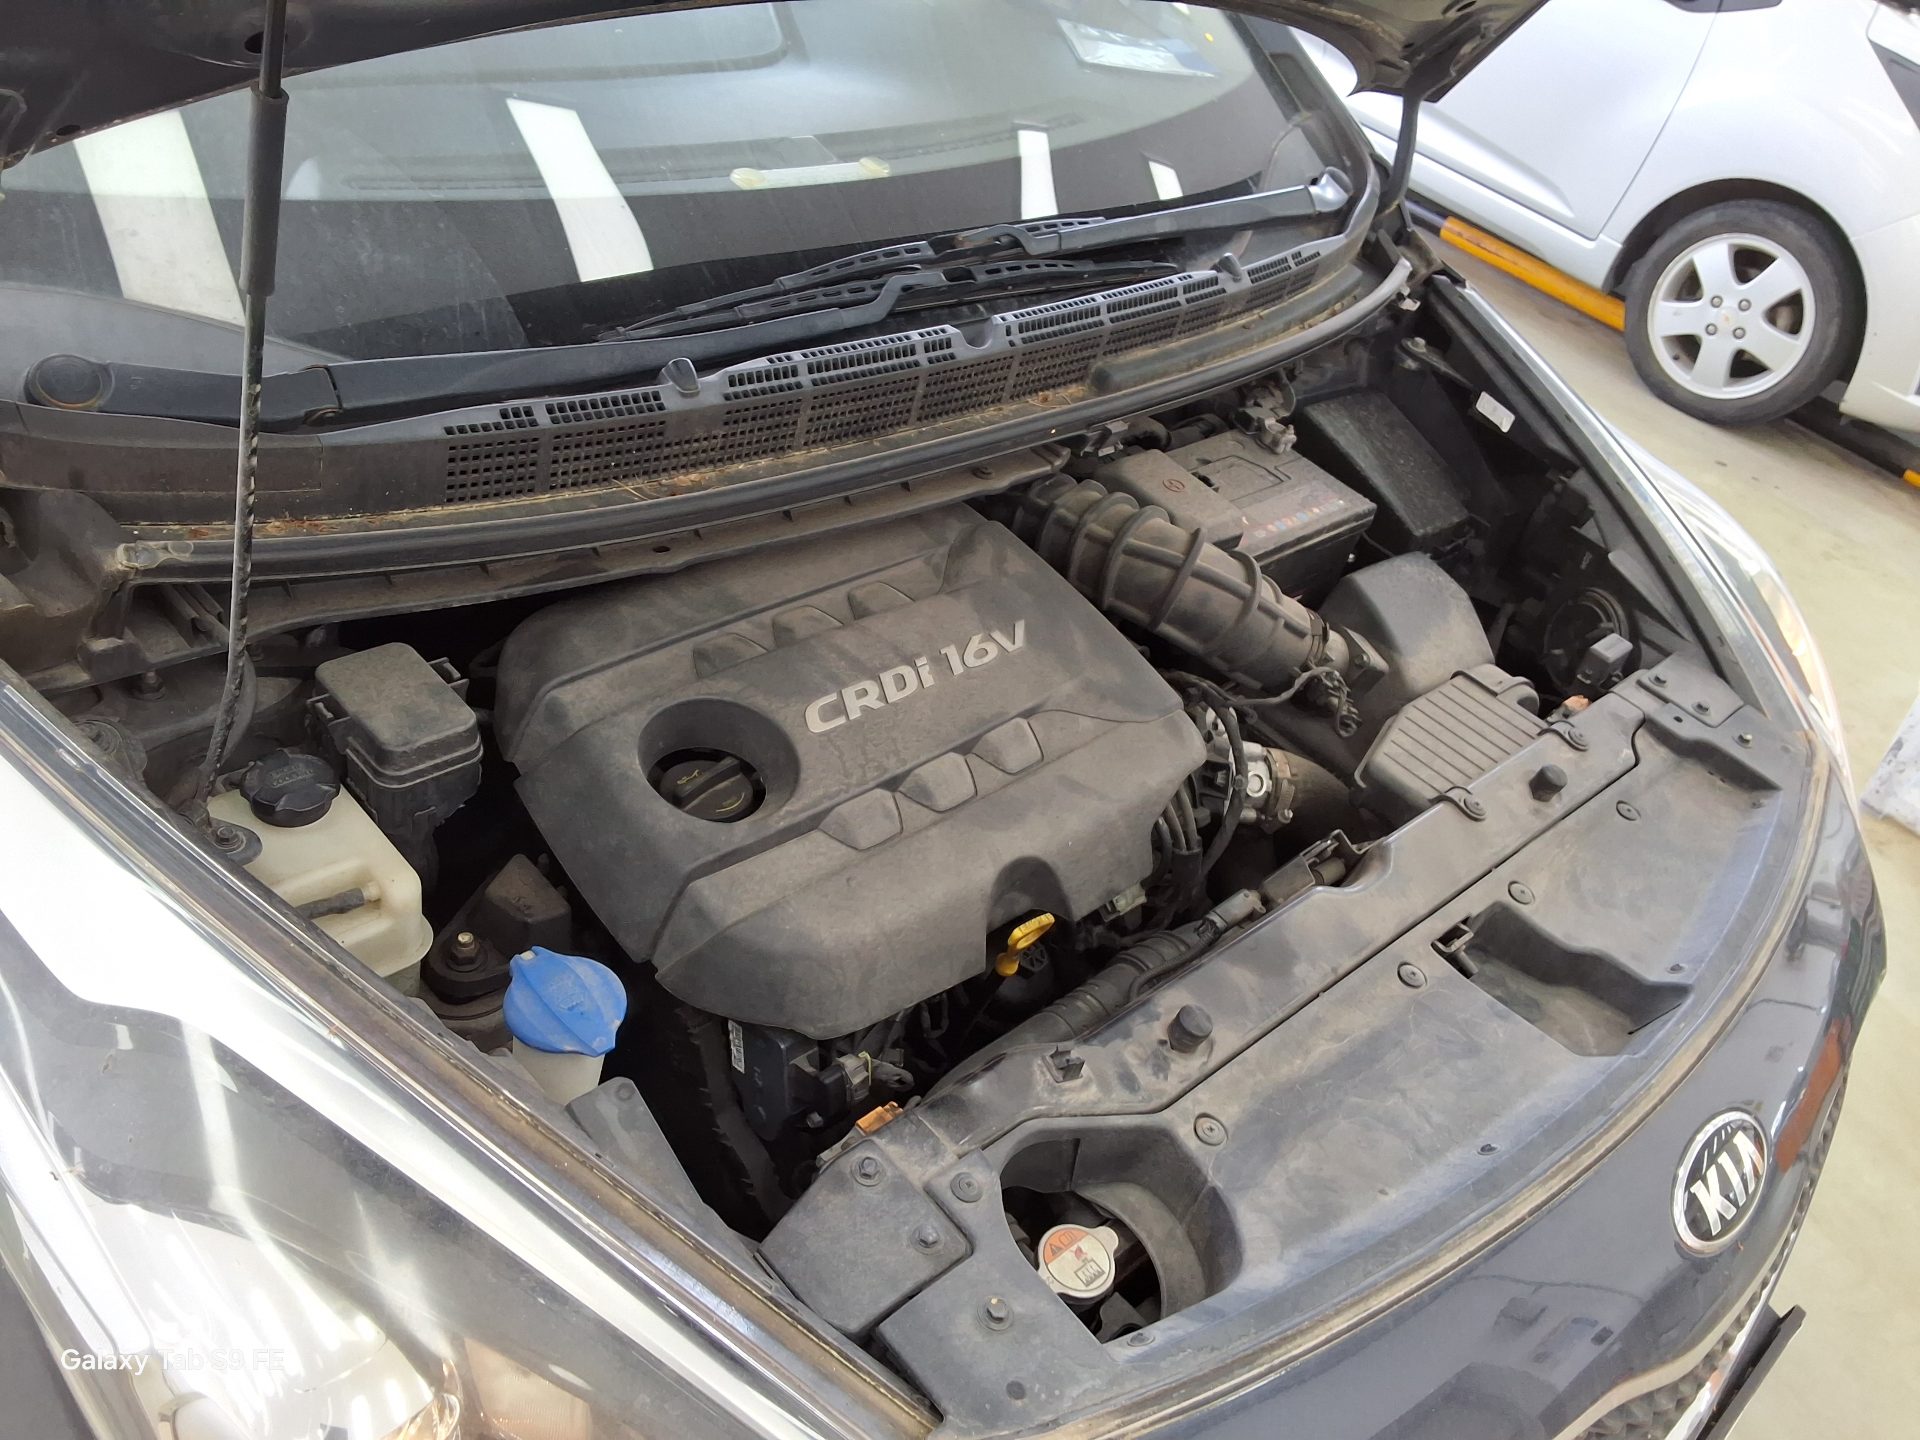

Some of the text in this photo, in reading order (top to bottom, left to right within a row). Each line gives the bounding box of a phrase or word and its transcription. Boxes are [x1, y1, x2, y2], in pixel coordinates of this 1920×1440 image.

[804, 619, 1025, 733] CRDi 16V
[1690, 1130, 1764, 1236] KIA
